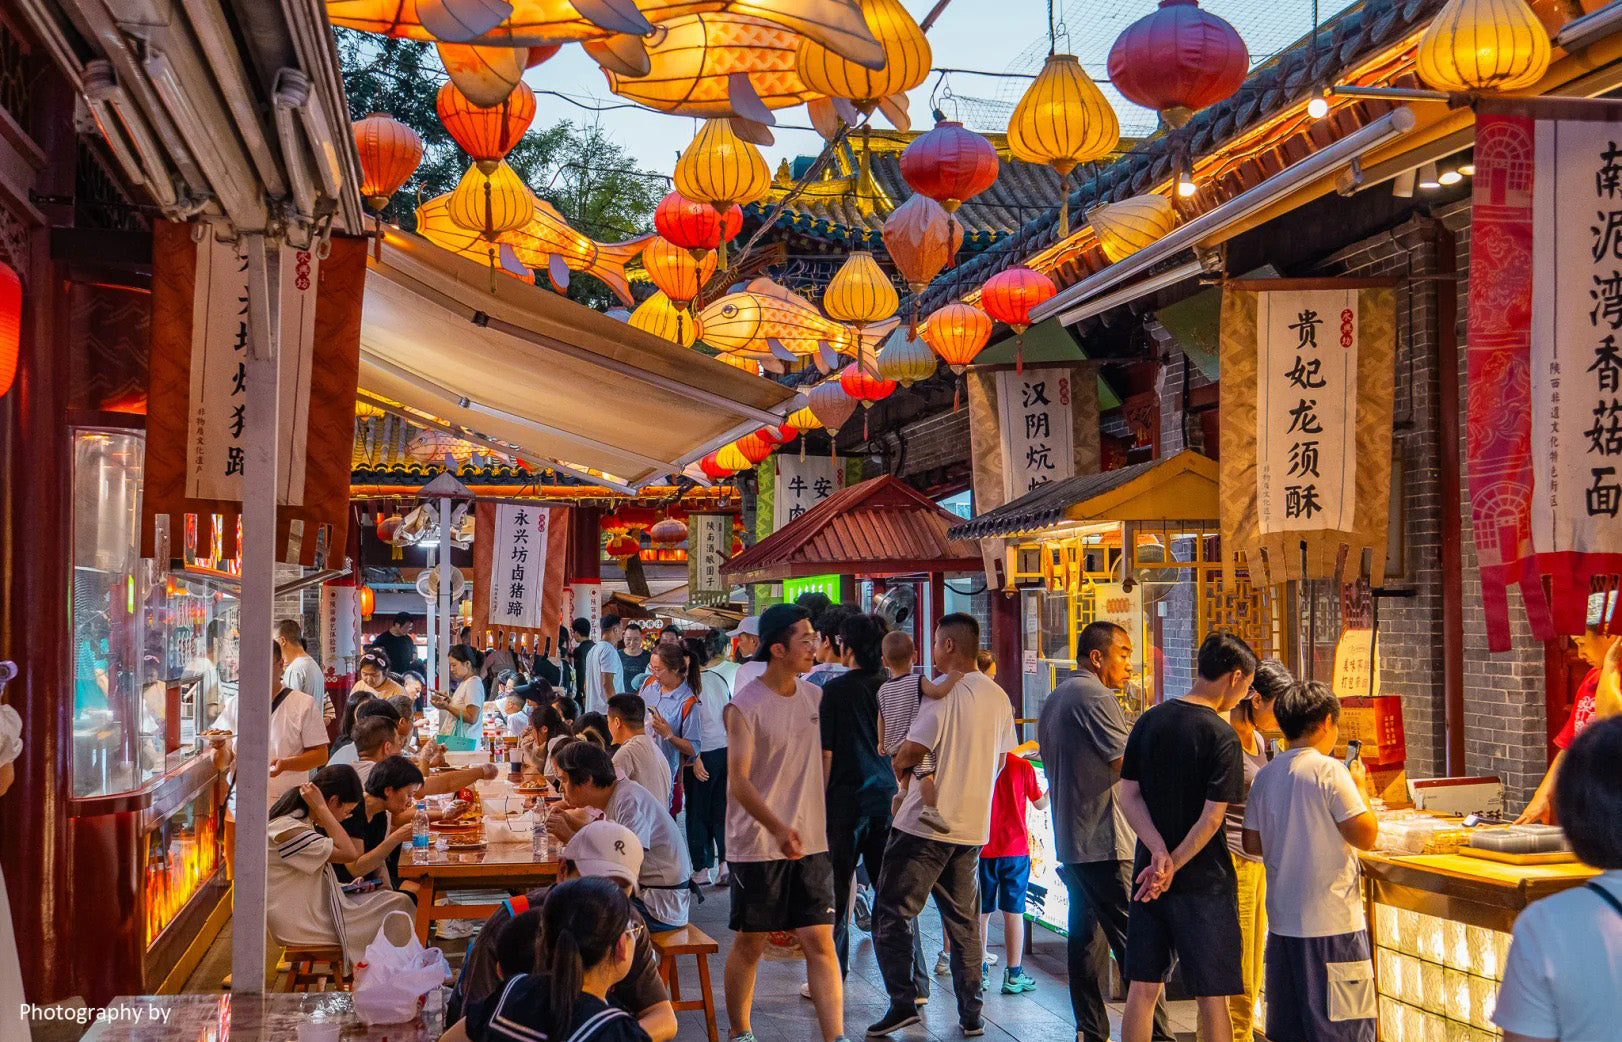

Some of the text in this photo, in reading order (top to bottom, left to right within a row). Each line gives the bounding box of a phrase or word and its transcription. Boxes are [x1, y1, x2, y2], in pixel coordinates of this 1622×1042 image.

[1583, 141, 1622, 519] 南泥湾香菇面
[1284, 309, 1327, 519] 贵妃龙须酥
[507, 508, 530, 618] 永兴坊卤猪蹄
[614, 840, 626, 855] R
